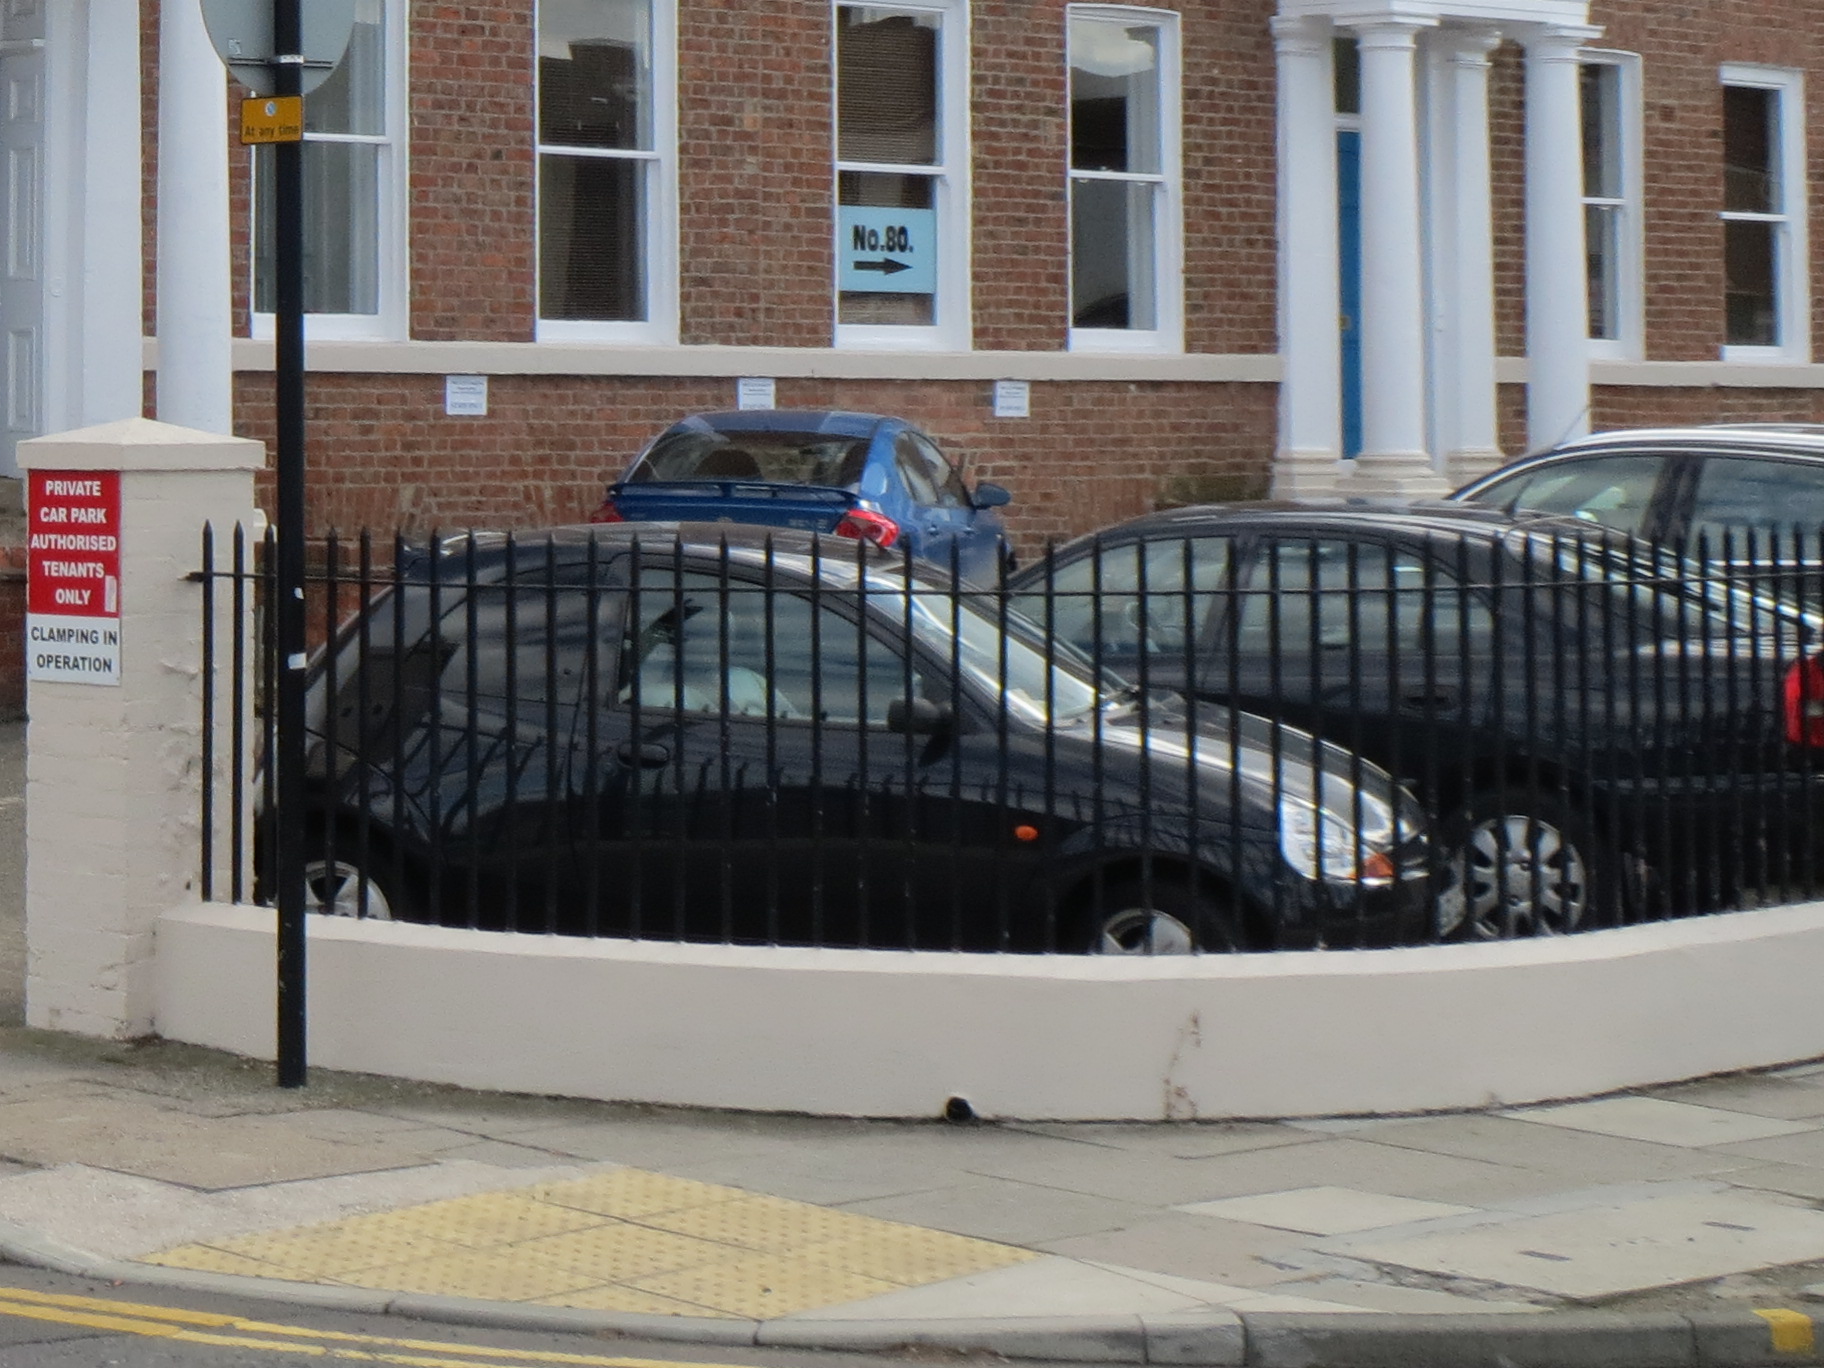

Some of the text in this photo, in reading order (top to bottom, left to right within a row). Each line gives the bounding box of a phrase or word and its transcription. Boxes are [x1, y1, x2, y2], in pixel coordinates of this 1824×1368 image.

[45, 481, 102, 496] PRIVATE
[40, 507, 107, 524] CAR PARK
[31, 534, 117, 551] AUTHORISED
[42, 561, 105, 578] TENANTS
[55, 589, 91, 605] ONLY
[31, 626, 118, 645] CLAMPING IN
[36, 654, 112, 673] OPERATION
